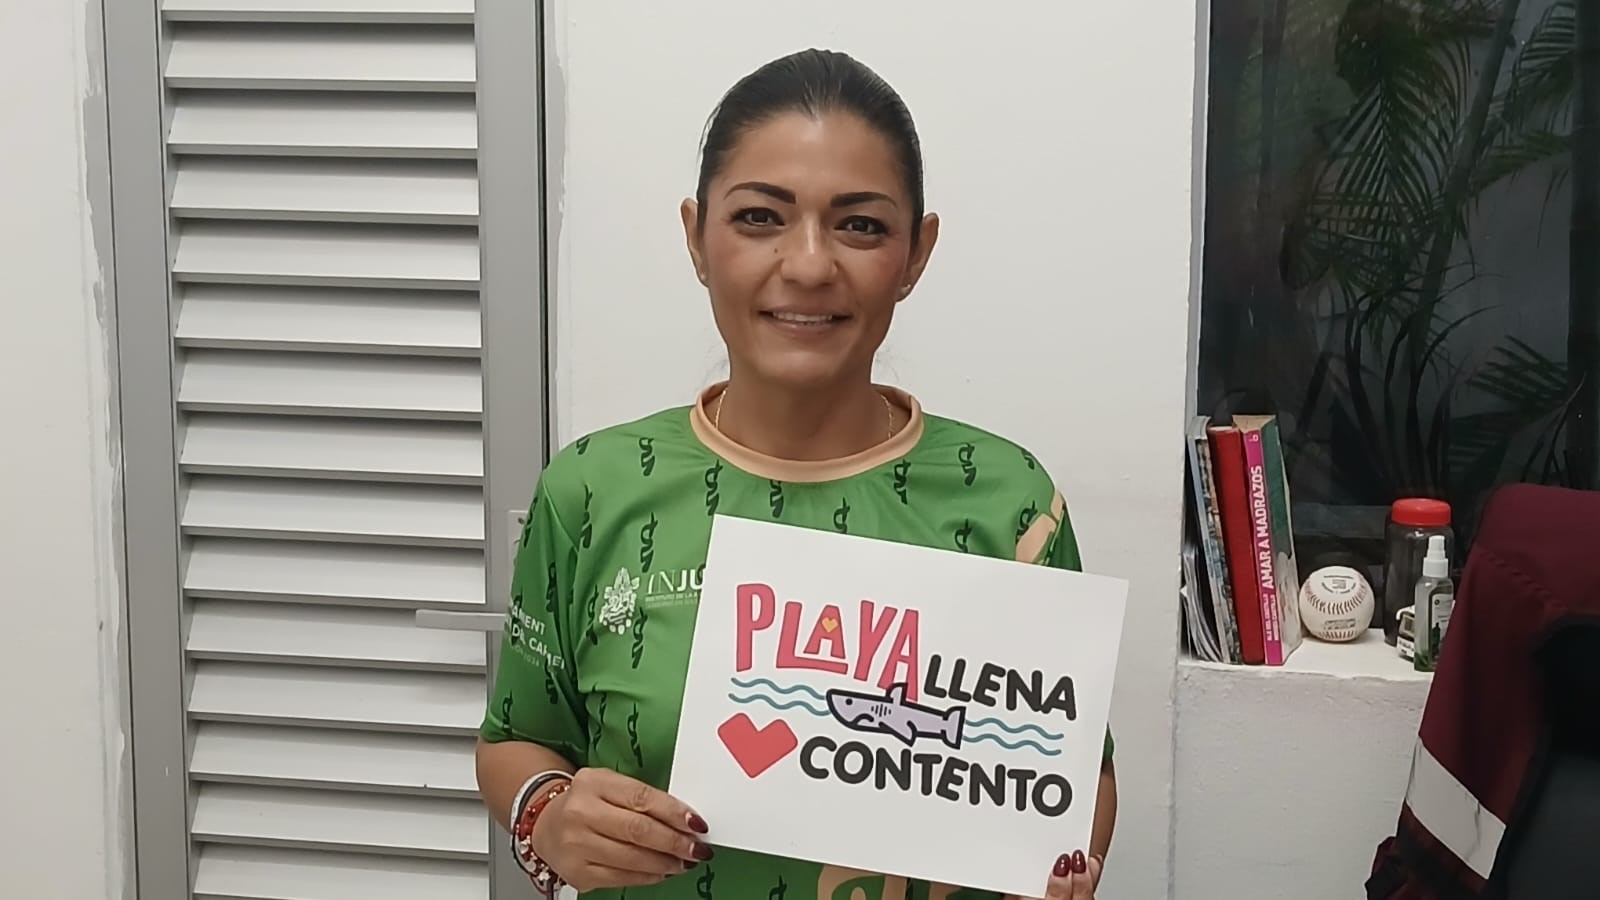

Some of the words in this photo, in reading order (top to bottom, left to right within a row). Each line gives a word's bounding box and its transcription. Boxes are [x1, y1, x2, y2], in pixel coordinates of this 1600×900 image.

[1250, 465, 1269, 538] MADRAZOS
[1258, 538, 1271, 549] A
[1260, 551, 1275, 590] AMAR
[736, 583, 919, 702] PLAYA
[923, 654, 1077, 721] LLENA
[799, 735, 1074, 818] CONTENTO
